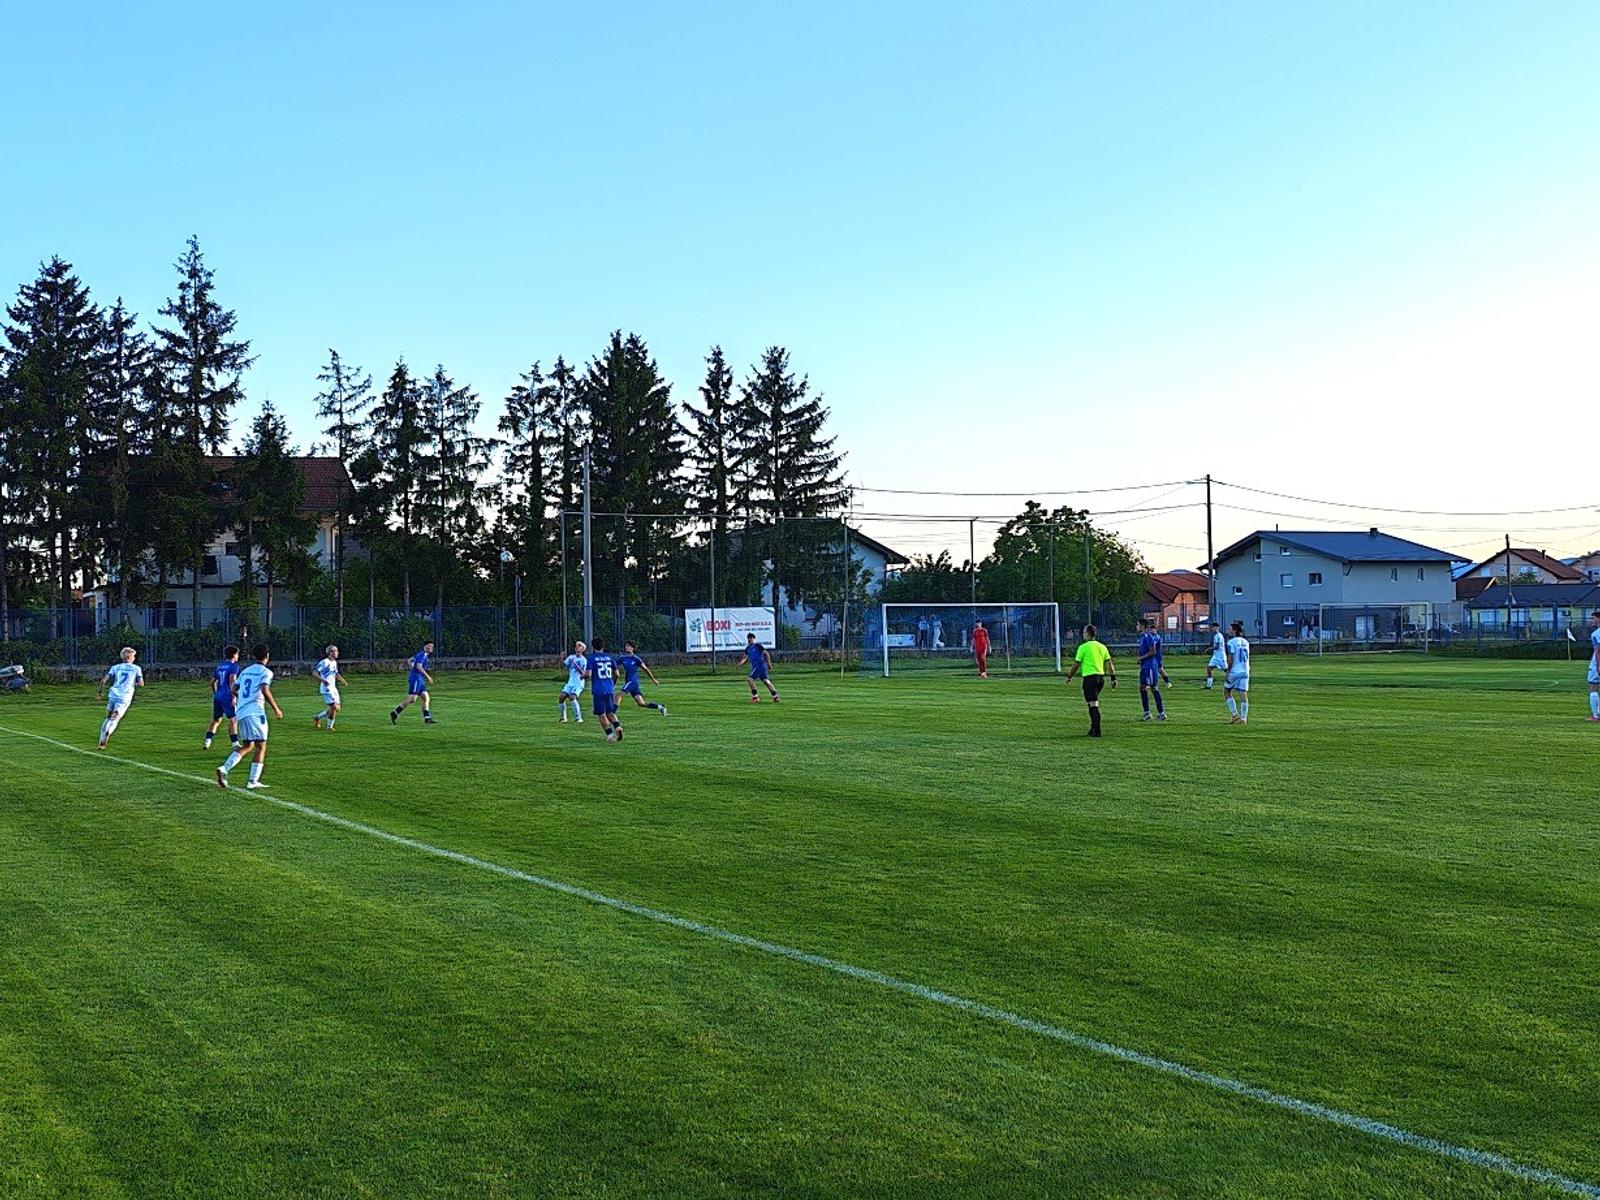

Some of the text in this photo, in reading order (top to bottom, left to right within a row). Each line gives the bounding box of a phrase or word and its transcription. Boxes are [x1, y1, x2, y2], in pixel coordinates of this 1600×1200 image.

[119, 672, 129, 686] 7
[596, 661, 612, 679] 26
[242, 678, 253, 698] 3
